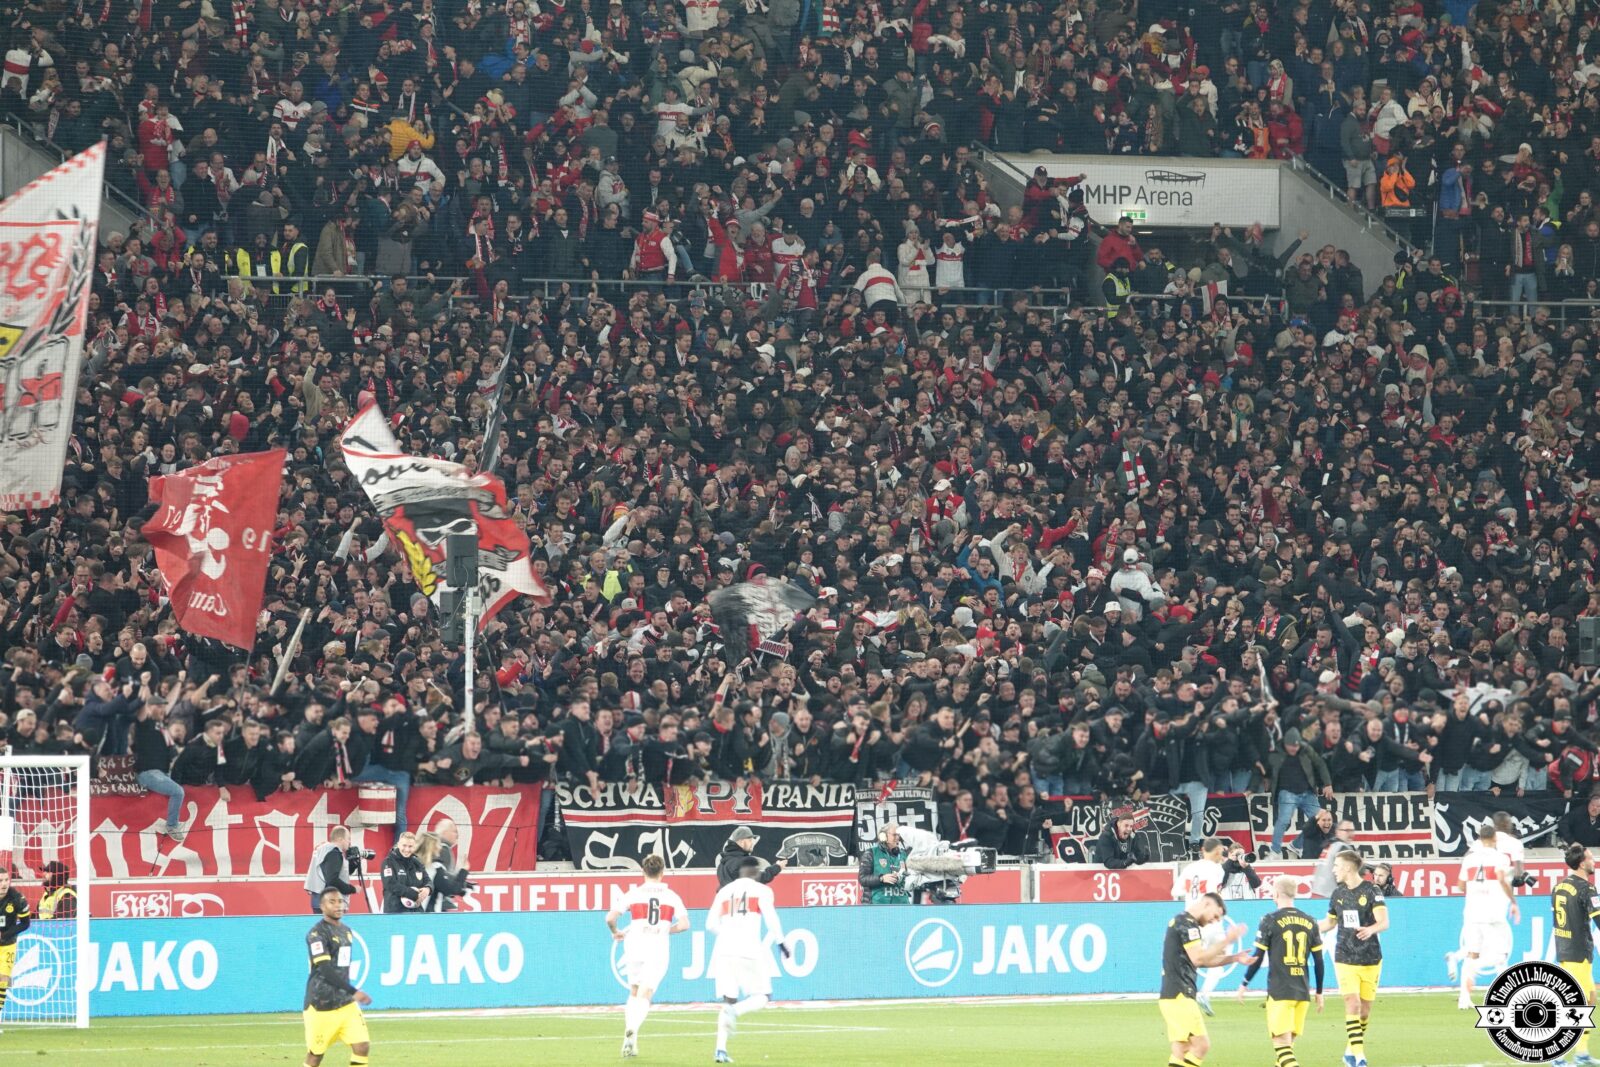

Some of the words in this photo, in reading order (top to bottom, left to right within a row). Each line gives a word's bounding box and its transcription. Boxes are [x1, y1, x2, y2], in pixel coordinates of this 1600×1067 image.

[1085, 184, 1131, 204] MHP
[1135, 184, 1193, 206] Arena
[1093, 873, 1121, 901] 36
[1475, 864, 1485, 883] 4
[648, 897, 660, 926] 6
[730, 890, 748, 917] 14
[1555, 895, 1567, 928] 5
[1277, 915, 1313, 930] DORTMUND
[380, 932, 525, 986] JAKO
[972, 922, 1108, 975] JAKO
[1282, 930, 1308, 966] 11
